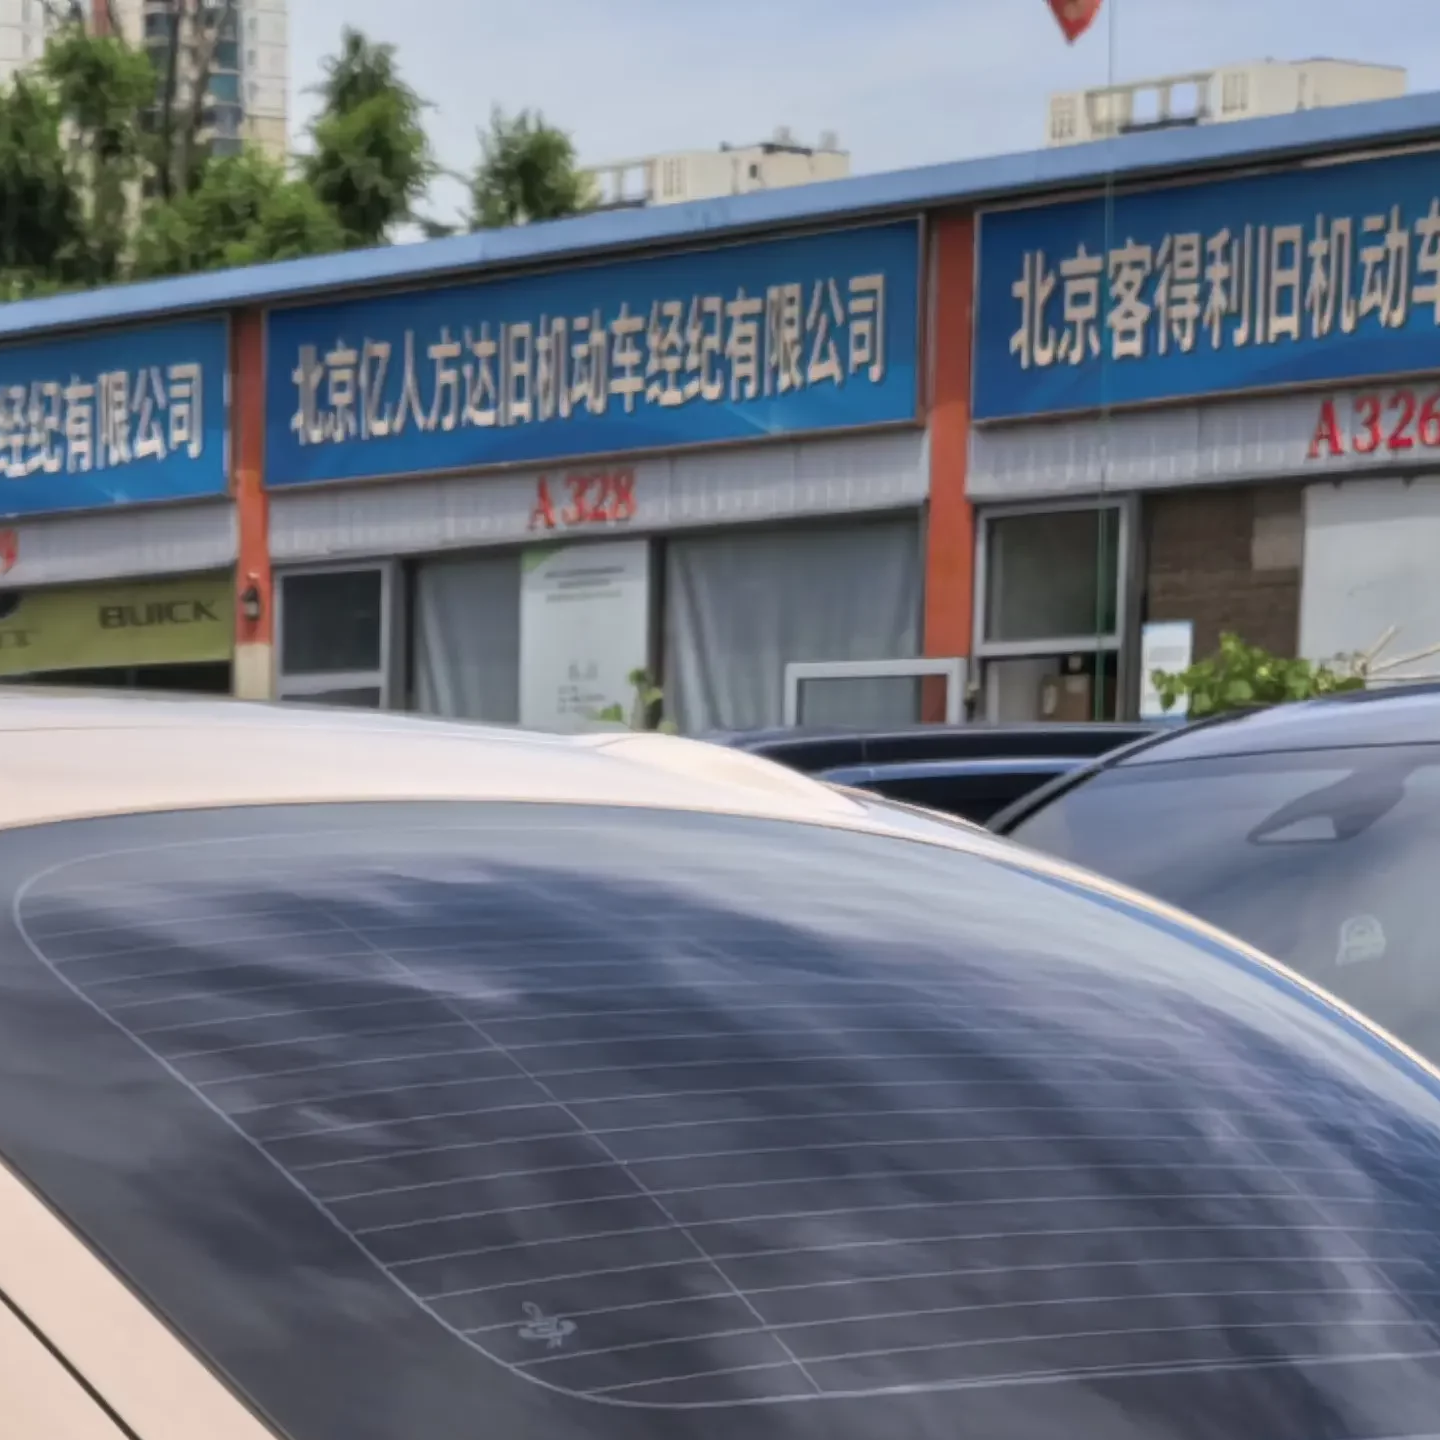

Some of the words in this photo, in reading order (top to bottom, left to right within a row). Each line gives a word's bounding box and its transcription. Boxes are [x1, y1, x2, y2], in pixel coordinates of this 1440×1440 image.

[290, 273, 886, 446] 北京亿人方达旧机动车经纪有限公司
